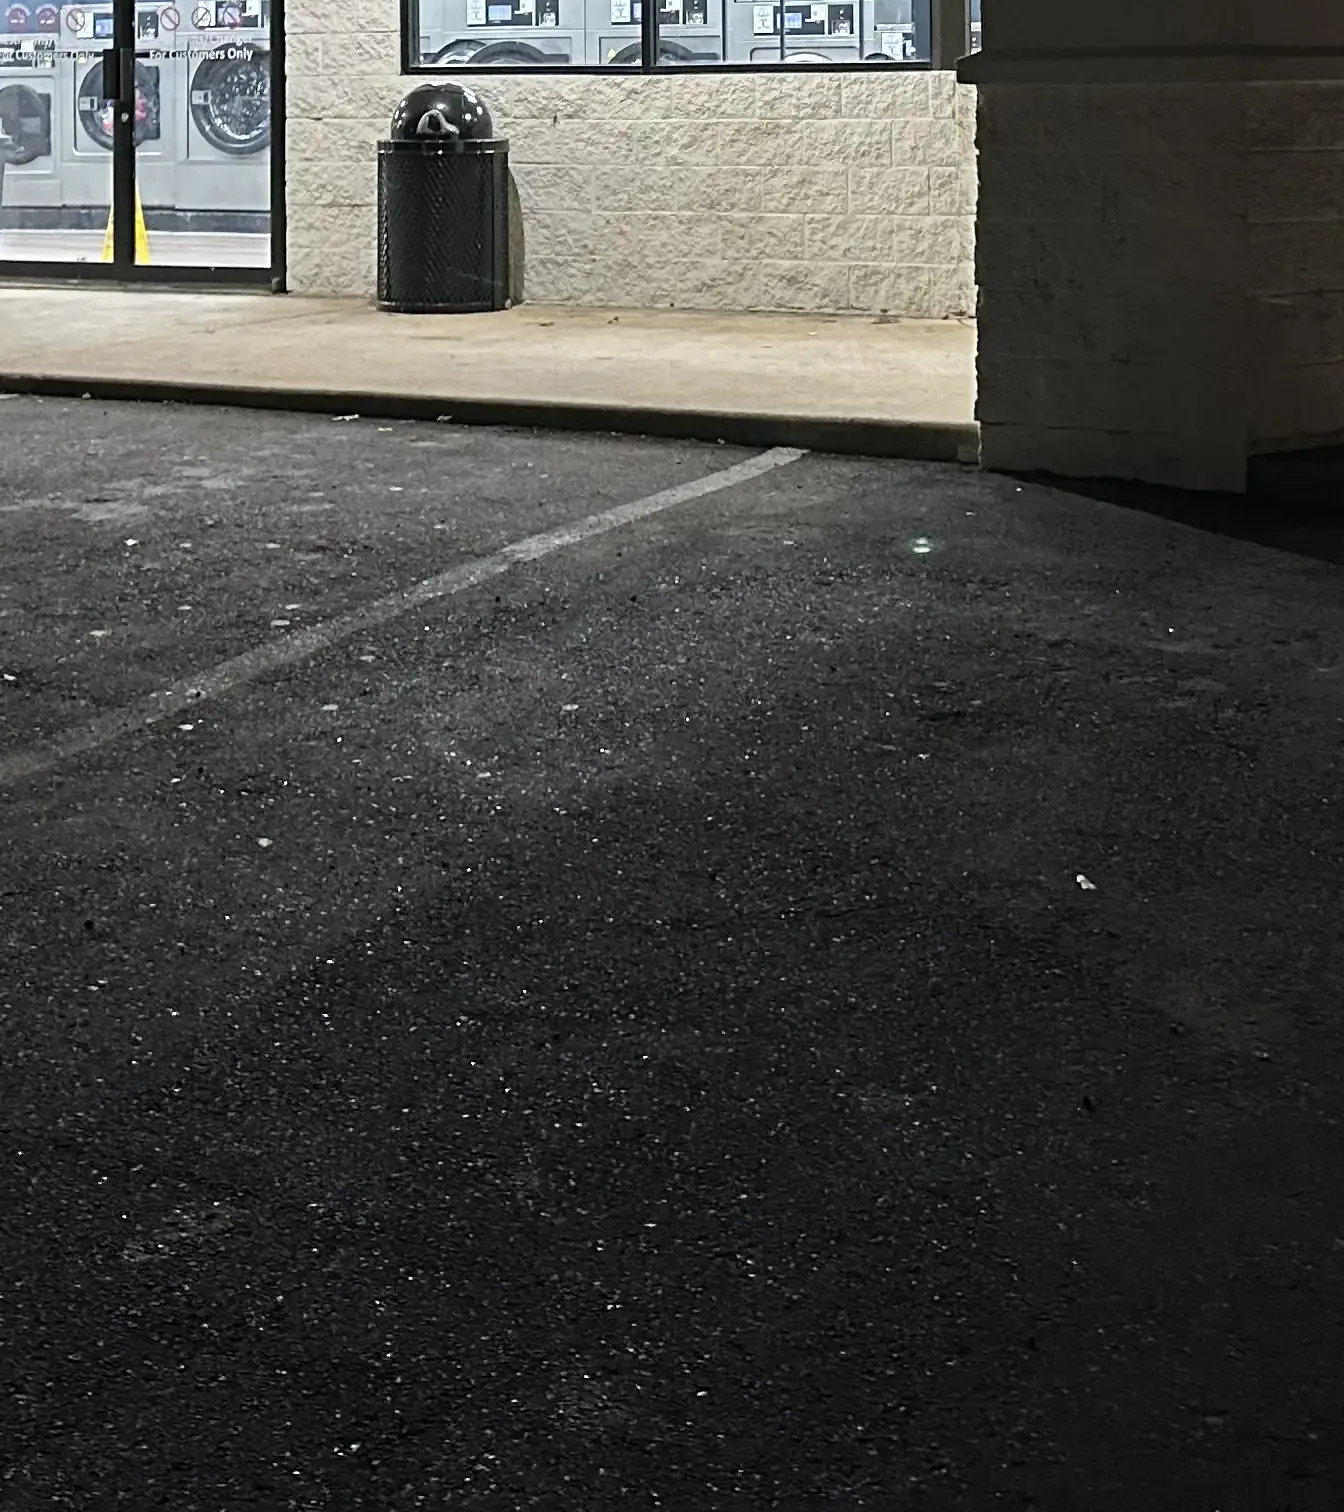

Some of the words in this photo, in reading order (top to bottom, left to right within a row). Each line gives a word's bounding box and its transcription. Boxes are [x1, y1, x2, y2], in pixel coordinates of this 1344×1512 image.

[150, 50, 166, 59] For
[170, 49, 225, 60] Customers
[227, 48, 253, 61] Only
